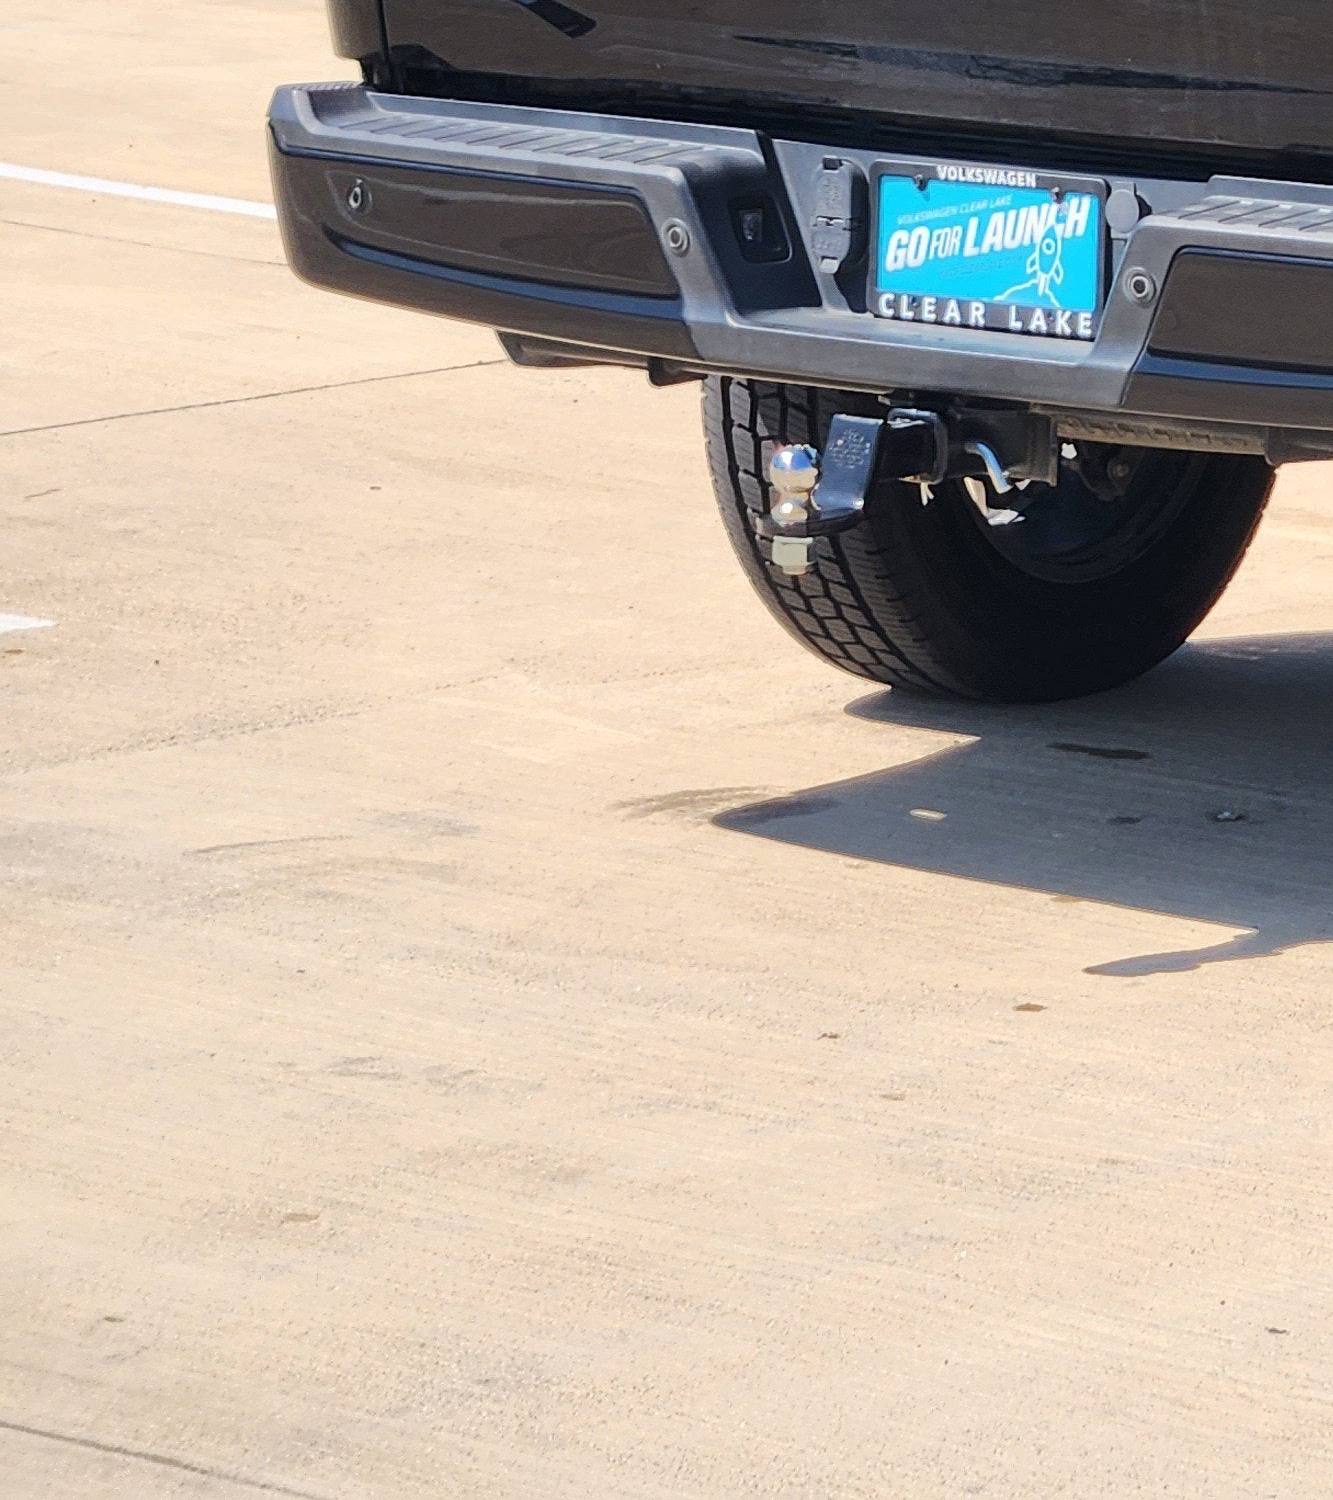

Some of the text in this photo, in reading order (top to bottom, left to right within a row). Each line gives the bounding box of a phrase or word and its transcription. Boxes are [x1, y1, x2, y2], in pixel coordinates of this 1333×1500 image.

[936, 165, 1037, 188] VOLKSWAGEN
[897, 194, 1012, 226] VOLKSWAGEN CLEAR LAKE
[886, 226, 930, 272] GO
[929, 225, 961, 260] FOR
[878, 292, 1093, 337] CLEAR LAKE
